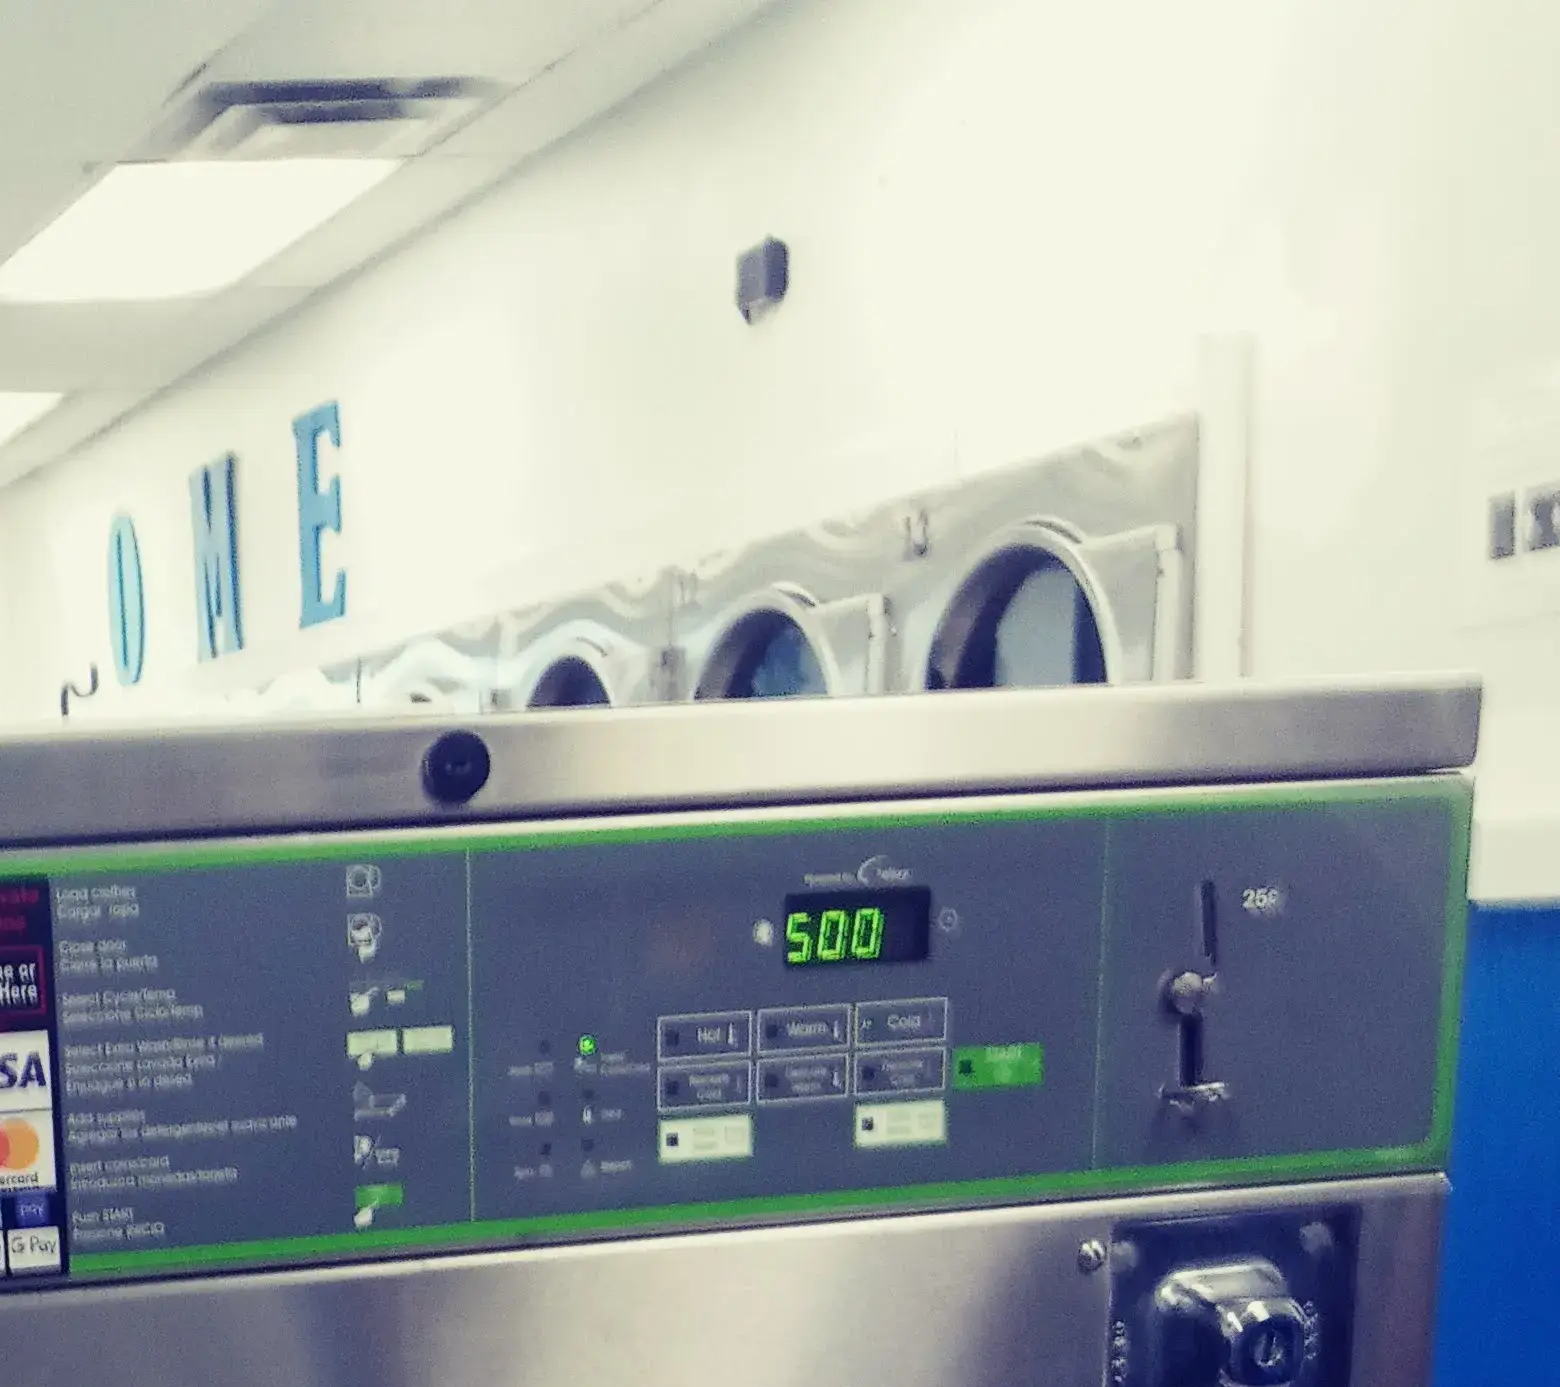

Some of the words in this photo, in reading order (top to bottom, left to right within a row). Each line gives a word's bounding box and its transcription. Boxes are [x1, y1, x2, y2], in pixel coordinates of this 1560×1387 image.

[786, 907, 884, 964] 500
[19, 963, 36, 982] or
[29, 1235, 58, 1256] Pay
